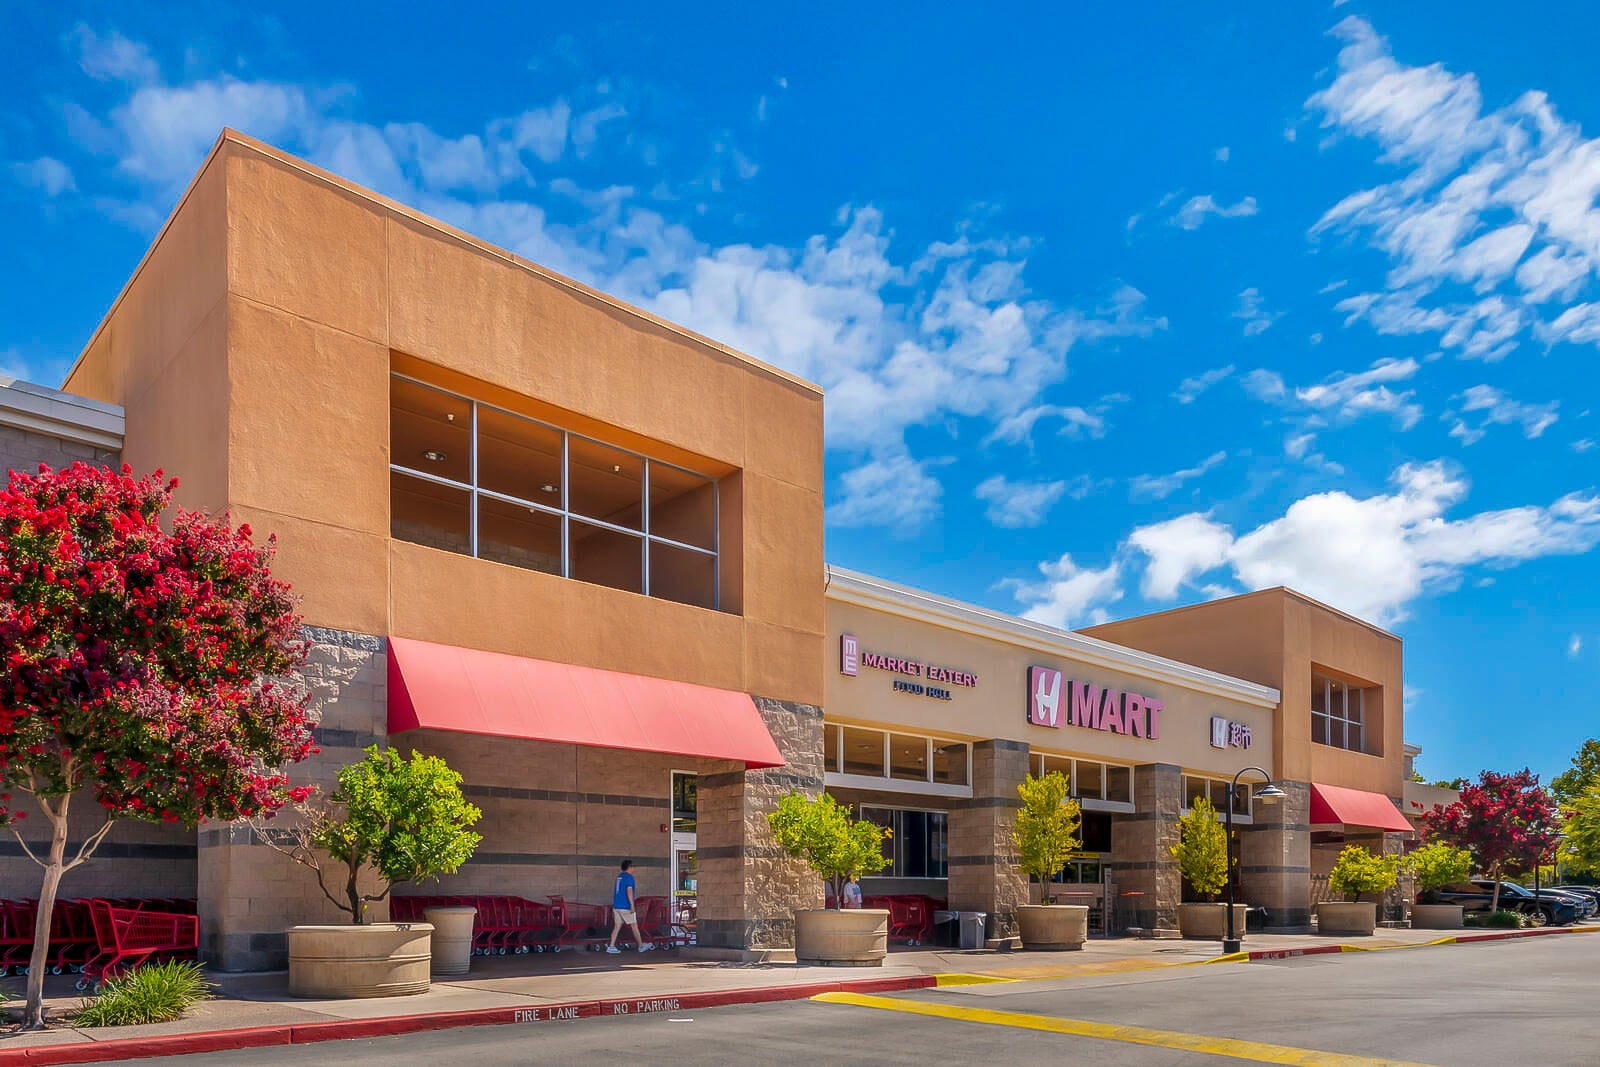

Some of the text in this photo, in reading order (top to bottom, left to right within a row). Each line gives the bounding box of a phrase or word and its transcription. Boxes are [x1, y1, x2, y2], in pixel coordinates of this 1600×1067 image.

[863, 652, 978, 687] MARKET EATERY
[1035, 671, 1163, 739] H MART
[514, 999, 680, 1023] FIRE LANE NO PARKING
